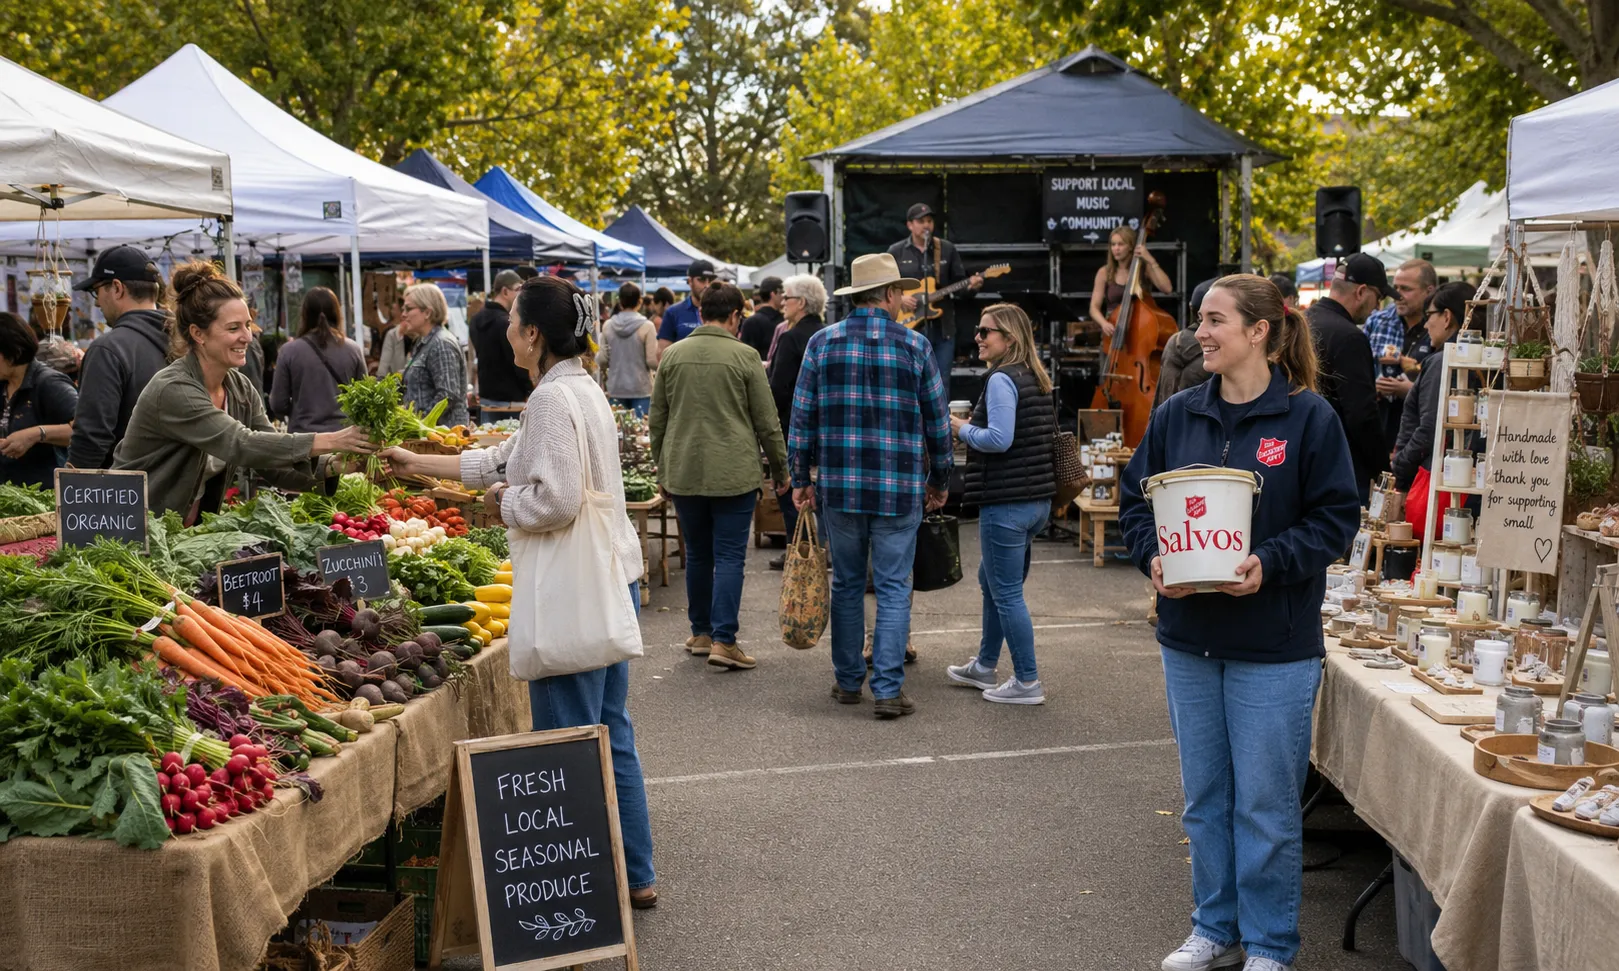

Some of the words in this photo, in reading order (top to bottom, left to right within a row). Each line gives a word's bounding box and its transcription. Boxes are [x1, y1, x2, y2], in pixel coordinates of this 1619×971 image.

[1051, 177, 1099, 191] SUPPORT
[1101, 177, 1136, 191] LOCAL
[1076, 196, 1110, 210] MUSIC
[1497, 426, 1557, 444] Handmade
[1502, 450, 1526, 464] with
[1530, 450, 1550, 465] love
[1494, 469, 1526, 485] thank
[1530, 476, 1551, 492] you
[63, 485, 139, 506] CERTIFIED
[1487, 489, 1504, 509] for
[1508, 494, 1557, 517] supporting
[1503, 515, 1535, 530] small
[1158, 520, 1243, 556] Salvos
[222, 566, 279, 592] BEETROOT
[497, 768, 566, 800] FRESH
[504, 805, 574, 835] LOCAL
[494, 837, 600, 874] SEASONAL
[504, 872, 593, 908] PRODUCE
